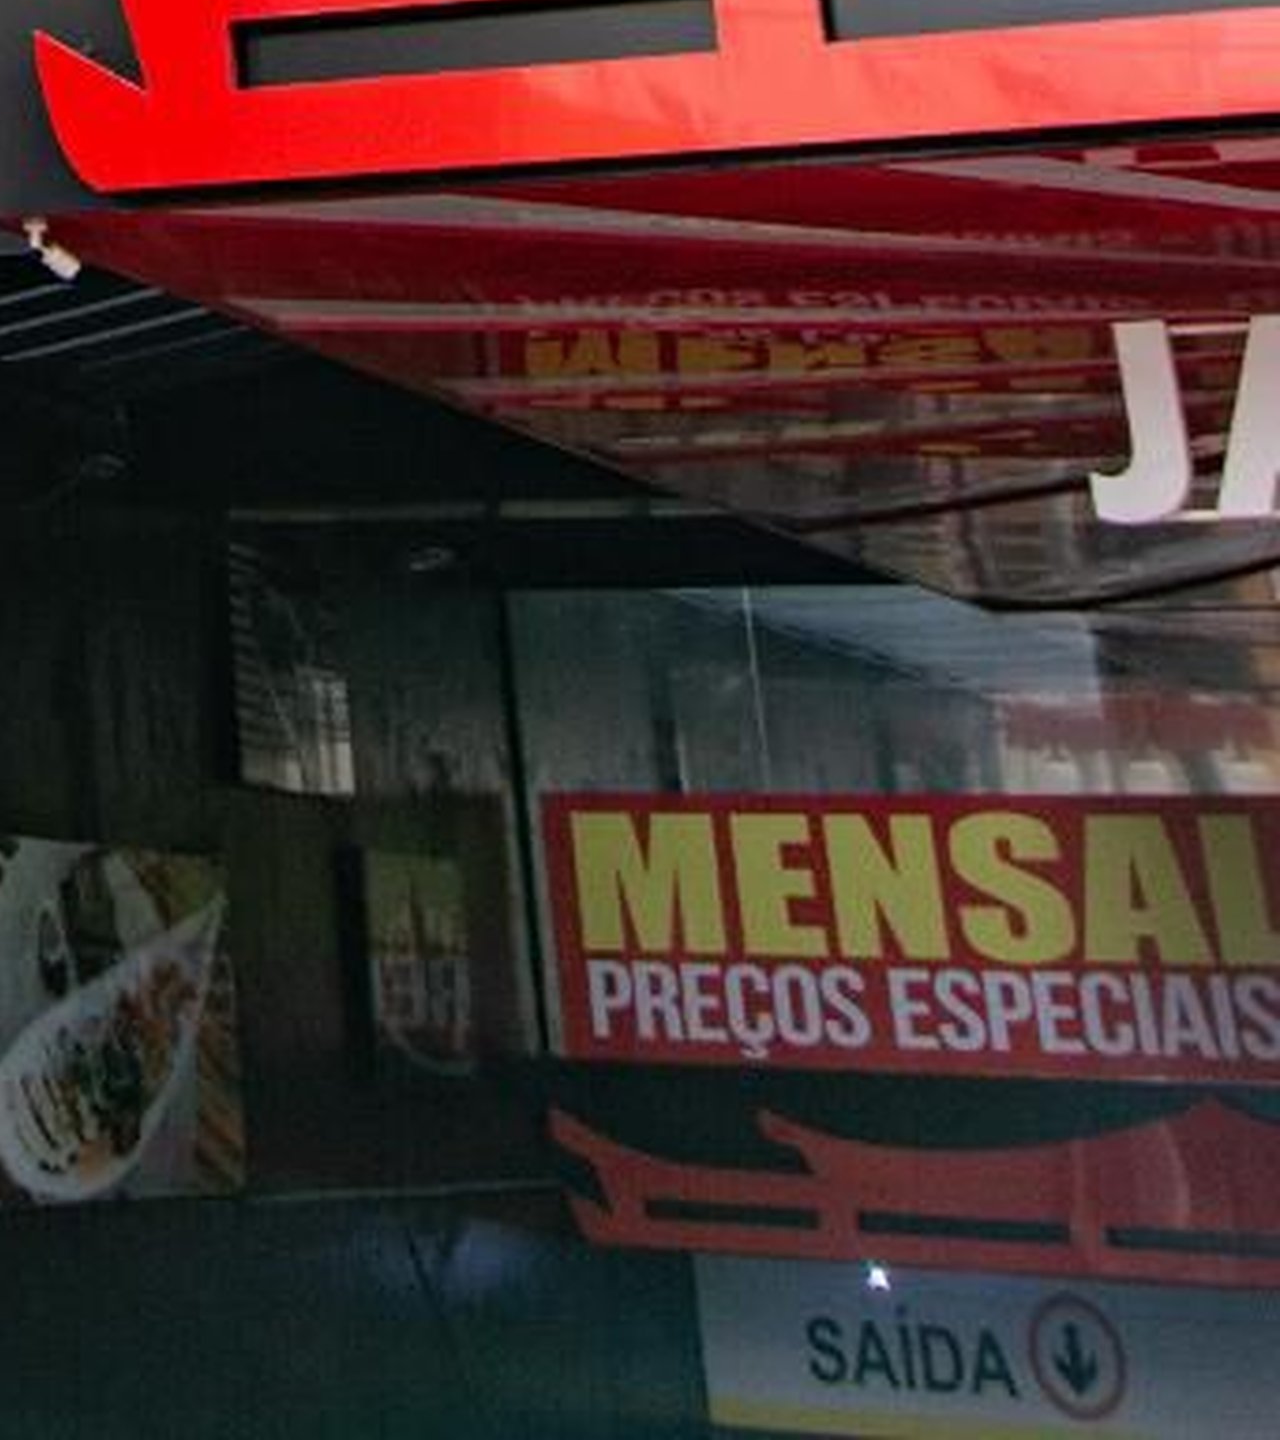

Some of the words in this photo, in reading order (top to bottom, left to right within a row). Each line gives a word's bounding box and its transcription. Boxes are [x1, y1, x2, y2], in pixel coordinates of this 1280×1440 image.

[585, 958, 872, 1060] PREÇOS
[887, 967, 1280, 1062] ESPECIAIS
[805, 1302, 1020, 1399] SAÍDA
